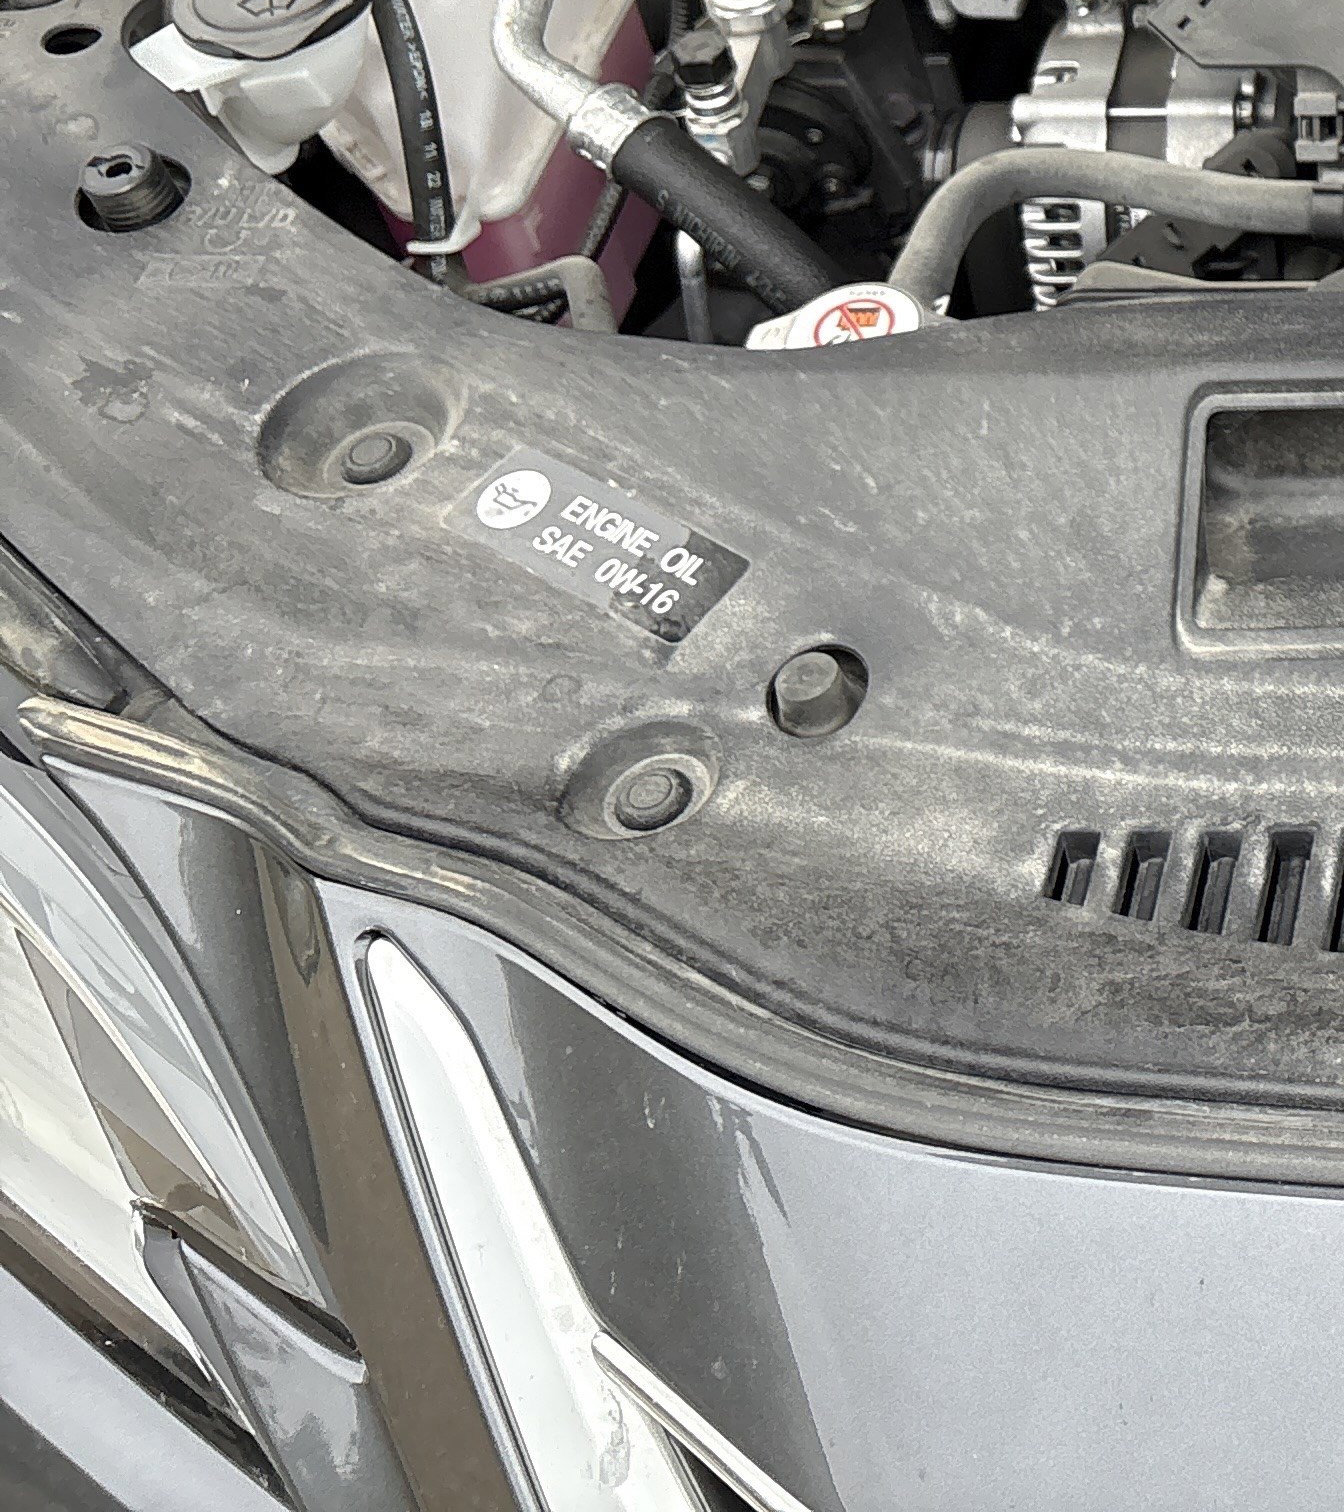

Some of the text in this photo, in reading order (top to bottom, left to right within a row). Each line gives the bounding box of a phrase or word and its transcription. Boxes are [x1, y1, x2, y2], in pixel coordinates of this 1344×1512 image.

[532, 525, 680, 614] SAE 0W-16
[560, 495, 704, 586] ENGINE OIL
